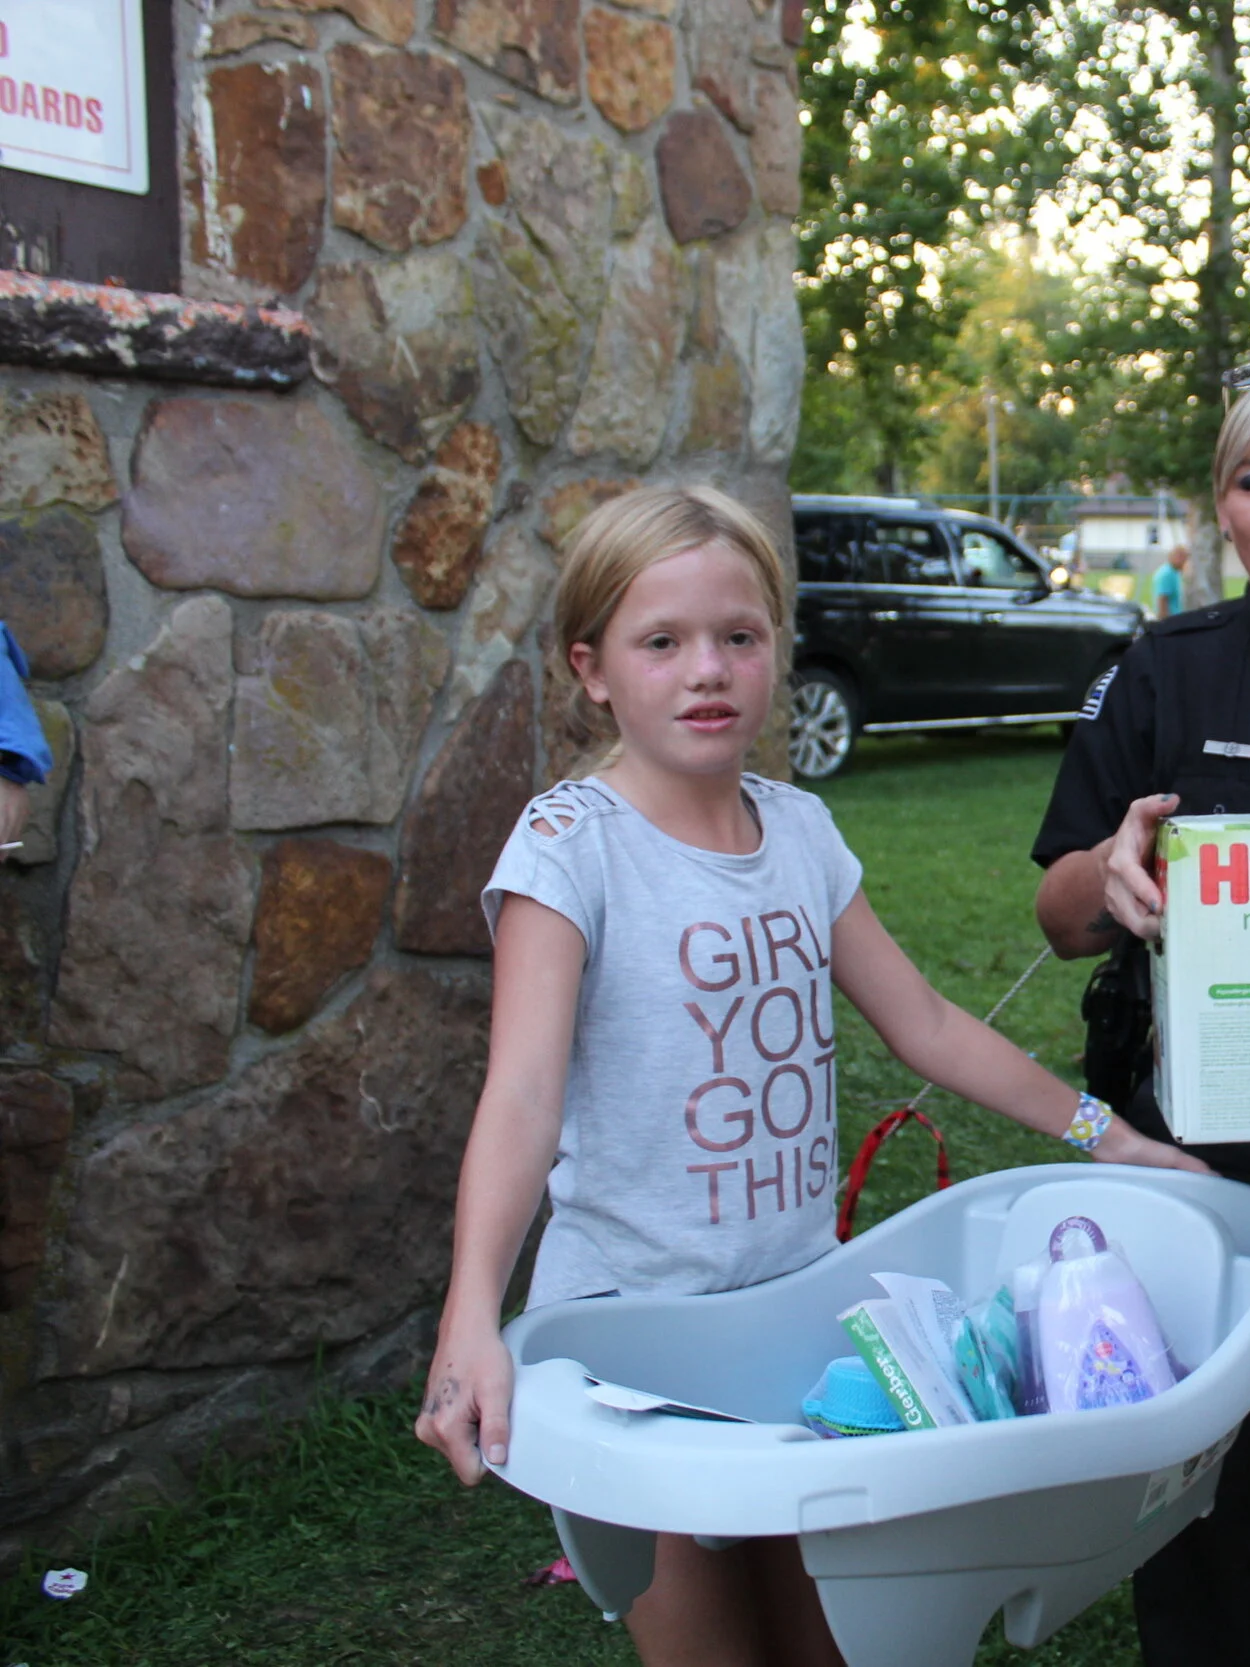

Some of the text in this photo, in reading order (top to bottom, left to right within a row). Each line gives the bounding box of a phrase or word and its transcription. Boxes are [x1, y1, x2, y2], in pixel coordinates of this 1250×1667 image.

[678, 905, 829, 992] GIRL
[682, 979, 834, 1073] YOU
[684, 1051, 835, 1152] GOT
[876, 1356, 922, 1426] Gerber
